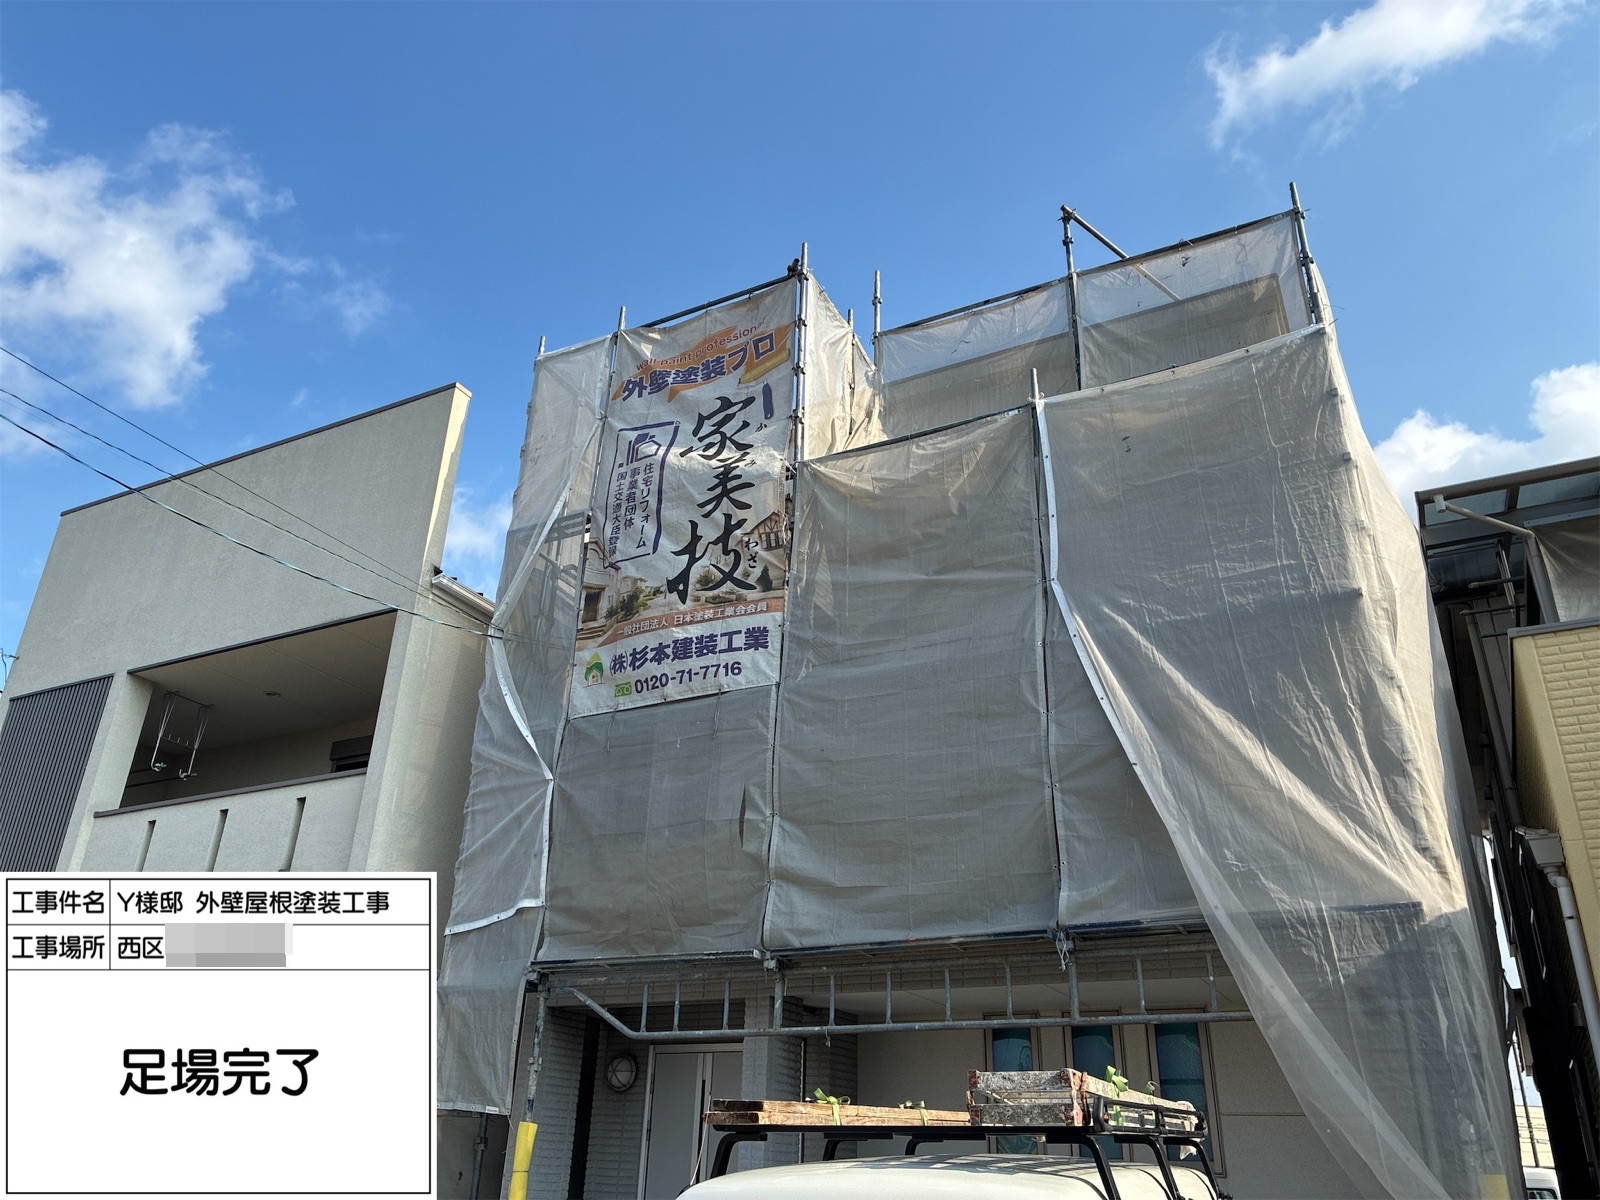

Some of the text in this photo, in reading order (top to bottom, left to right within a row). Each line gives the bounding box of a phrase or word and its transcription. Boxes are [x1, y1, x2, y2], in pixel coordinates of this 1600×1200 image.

[622, 331, 775, 401] 外壁塗装プロ
[659, 351, 693, 367] paint
[695, 318, 766, 358] professional
[608, 471, 628, 559] 国土交通大臣登録
[623, 467, 641, 531] 事業者団体
[636, 463, 654, 549] 住宅リフォーム
[616, 600, 767, 636] 一般社団法人 日本塗装工業会会員
[634, 661, 742, 694] 0120-71-7716
